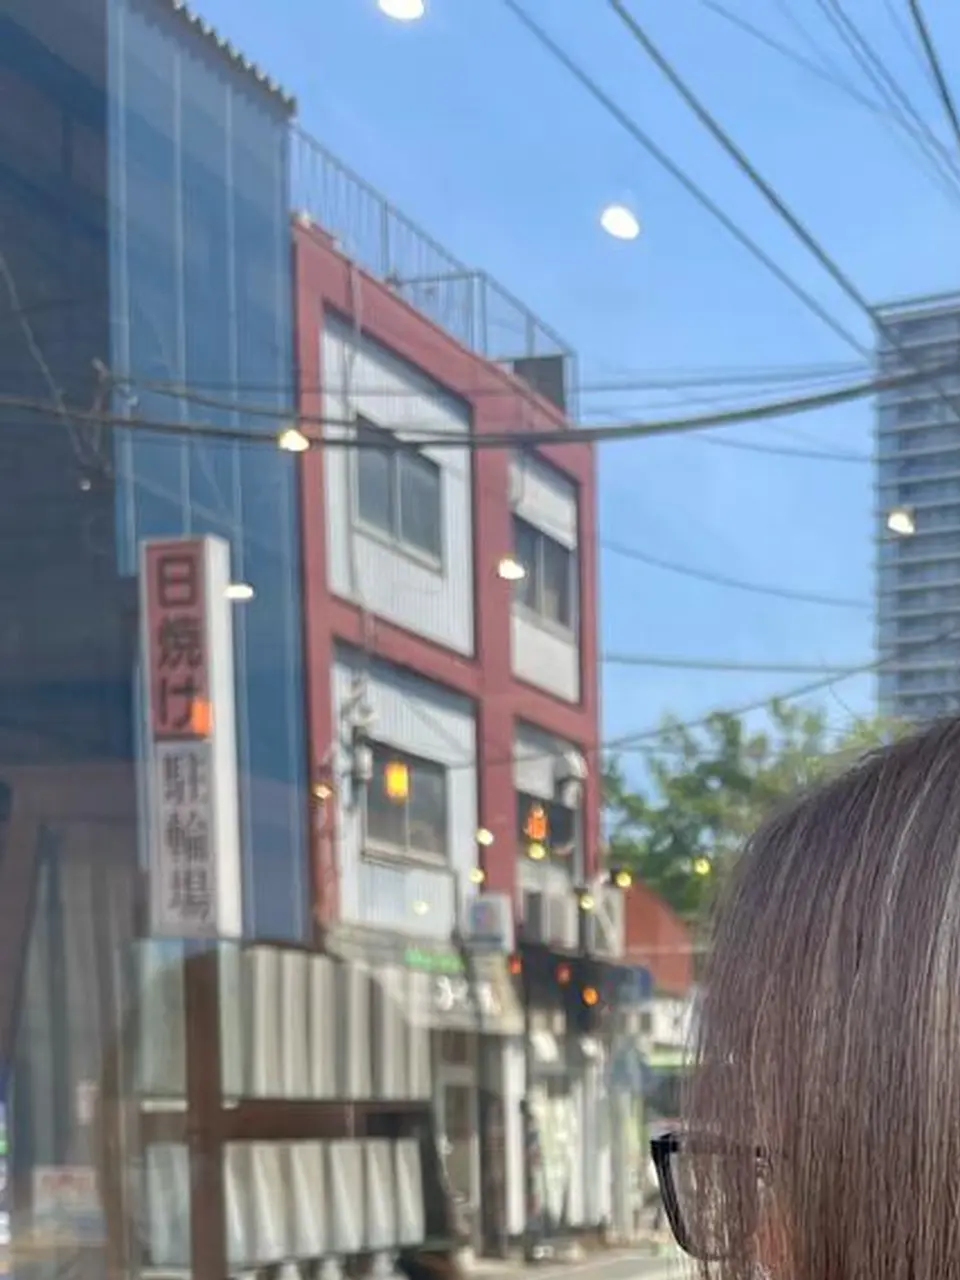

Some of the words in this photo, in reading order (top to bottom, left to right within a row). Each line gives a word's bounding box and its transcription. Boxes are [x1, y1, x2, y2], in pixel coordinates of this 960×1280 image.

[157, 554, 204, 730] 日焼け
[163, 752, 211, 924] 駐輪場
